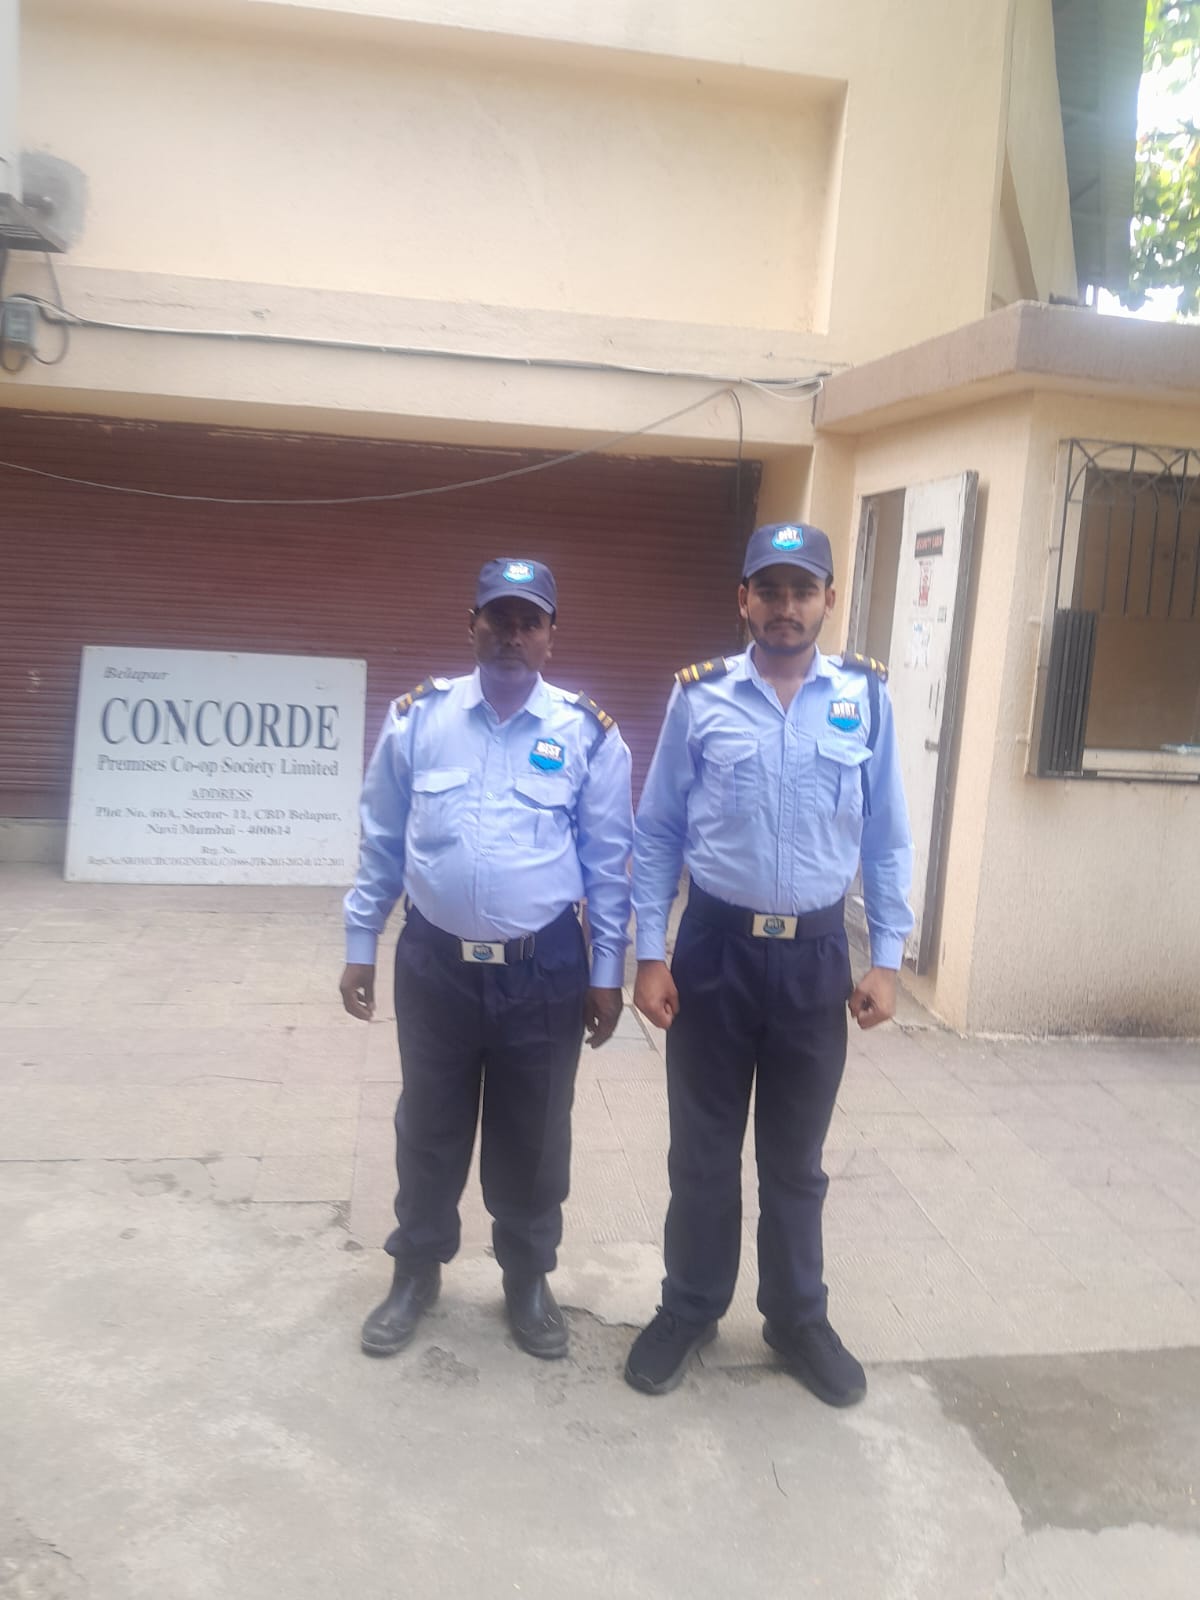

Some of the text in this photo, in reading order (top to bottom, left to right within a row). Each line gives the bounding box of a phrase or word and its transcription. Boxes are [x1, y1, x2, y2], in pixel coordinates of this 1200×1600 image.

[101, 697, 339, 750] CONCORDE
[98, 754, 338, 778] Premises Co-op Society Limited
[191, 787, 253, 800] ADDRESS
[254, 809, 286, 820] CBD
[180, 823, 236, 835] Mumbai
